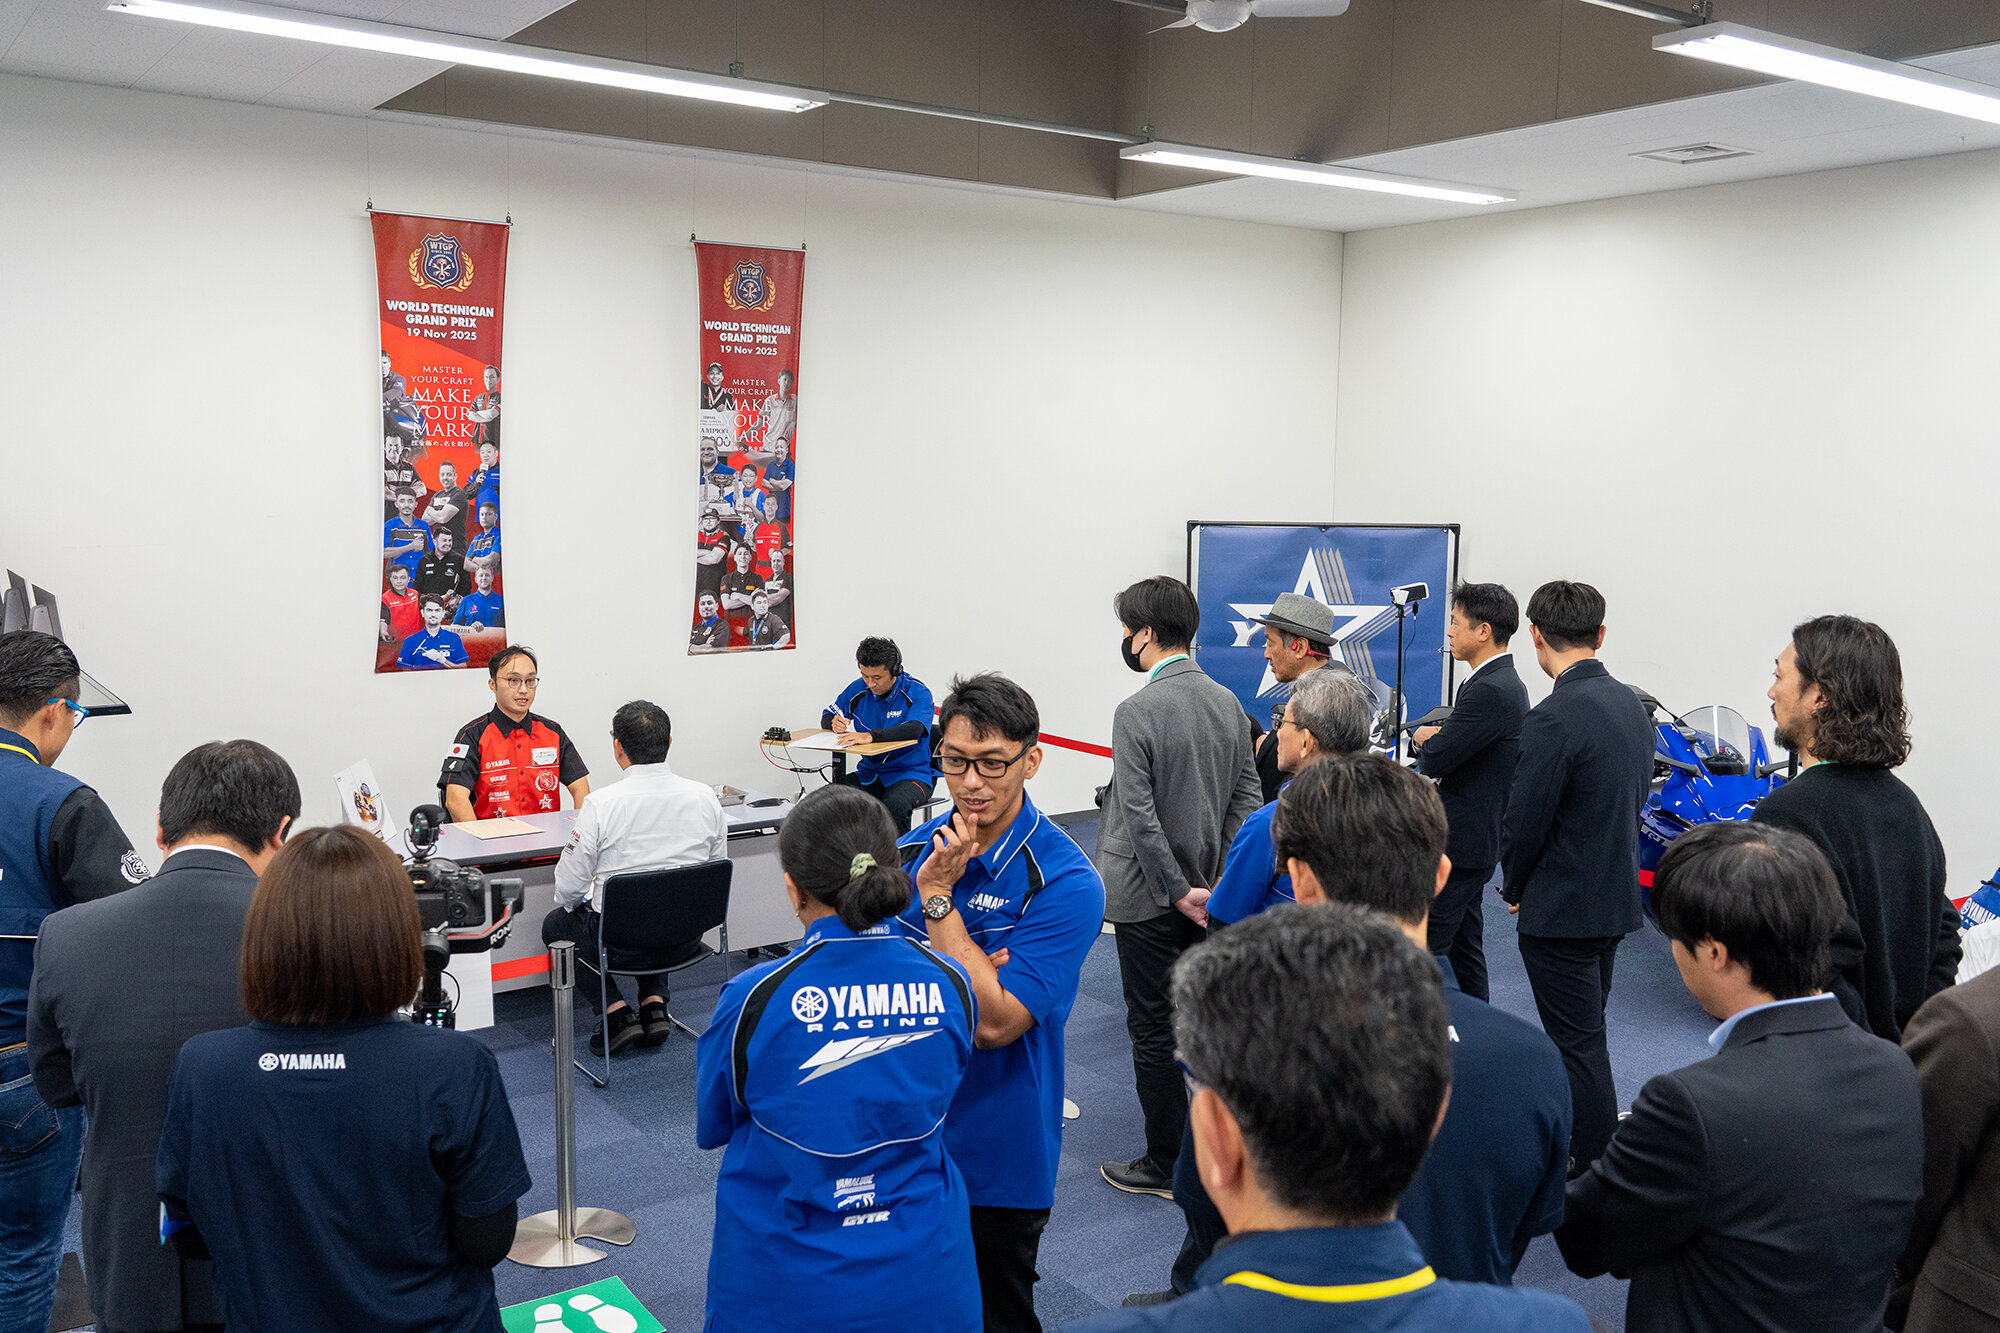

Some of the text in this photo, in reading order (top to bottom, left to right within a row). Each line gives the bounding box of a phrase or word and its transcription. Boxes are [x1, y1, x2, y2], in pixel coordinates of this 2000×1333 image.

[430, 241, 453, 251] WTGP
[741, 267, 760, 276] WTGP
[386, 300, 494, 317] WORLD TECHNICIAN
[405, 314, 477, 328] GRAND PRIX
[704, 320, 791, 334] WORLD TECHNICIAN
[407, 327, 477, 341] 19 Nov 2025
[720, 332, 777, 344] GRAND PRIX
[720, 345, 777, 355] 19 Nov 2025
[422, 366, 464, 375] MASTER
[411, 375, 474, 385] YOUR CRAFT
[412, 387, 471, 404] MAKE
[723, 387, 774, 396] YOUR CRAFT
[724, 398, 772, 412] MAKE
[411, 404, 471, 421] YOUR
[723, 413, 772, 428] YOUR
[412, 422, 474, 438] MARK
[726, 430, 772, 443] MARK
[828, 983, 945, 1018] YAMAHA
[807, 1016, 940, 1033] RACING
[279, 1053, 346, 1070] YAMAHA
[842, 1210, 891, 1227] GYTR
